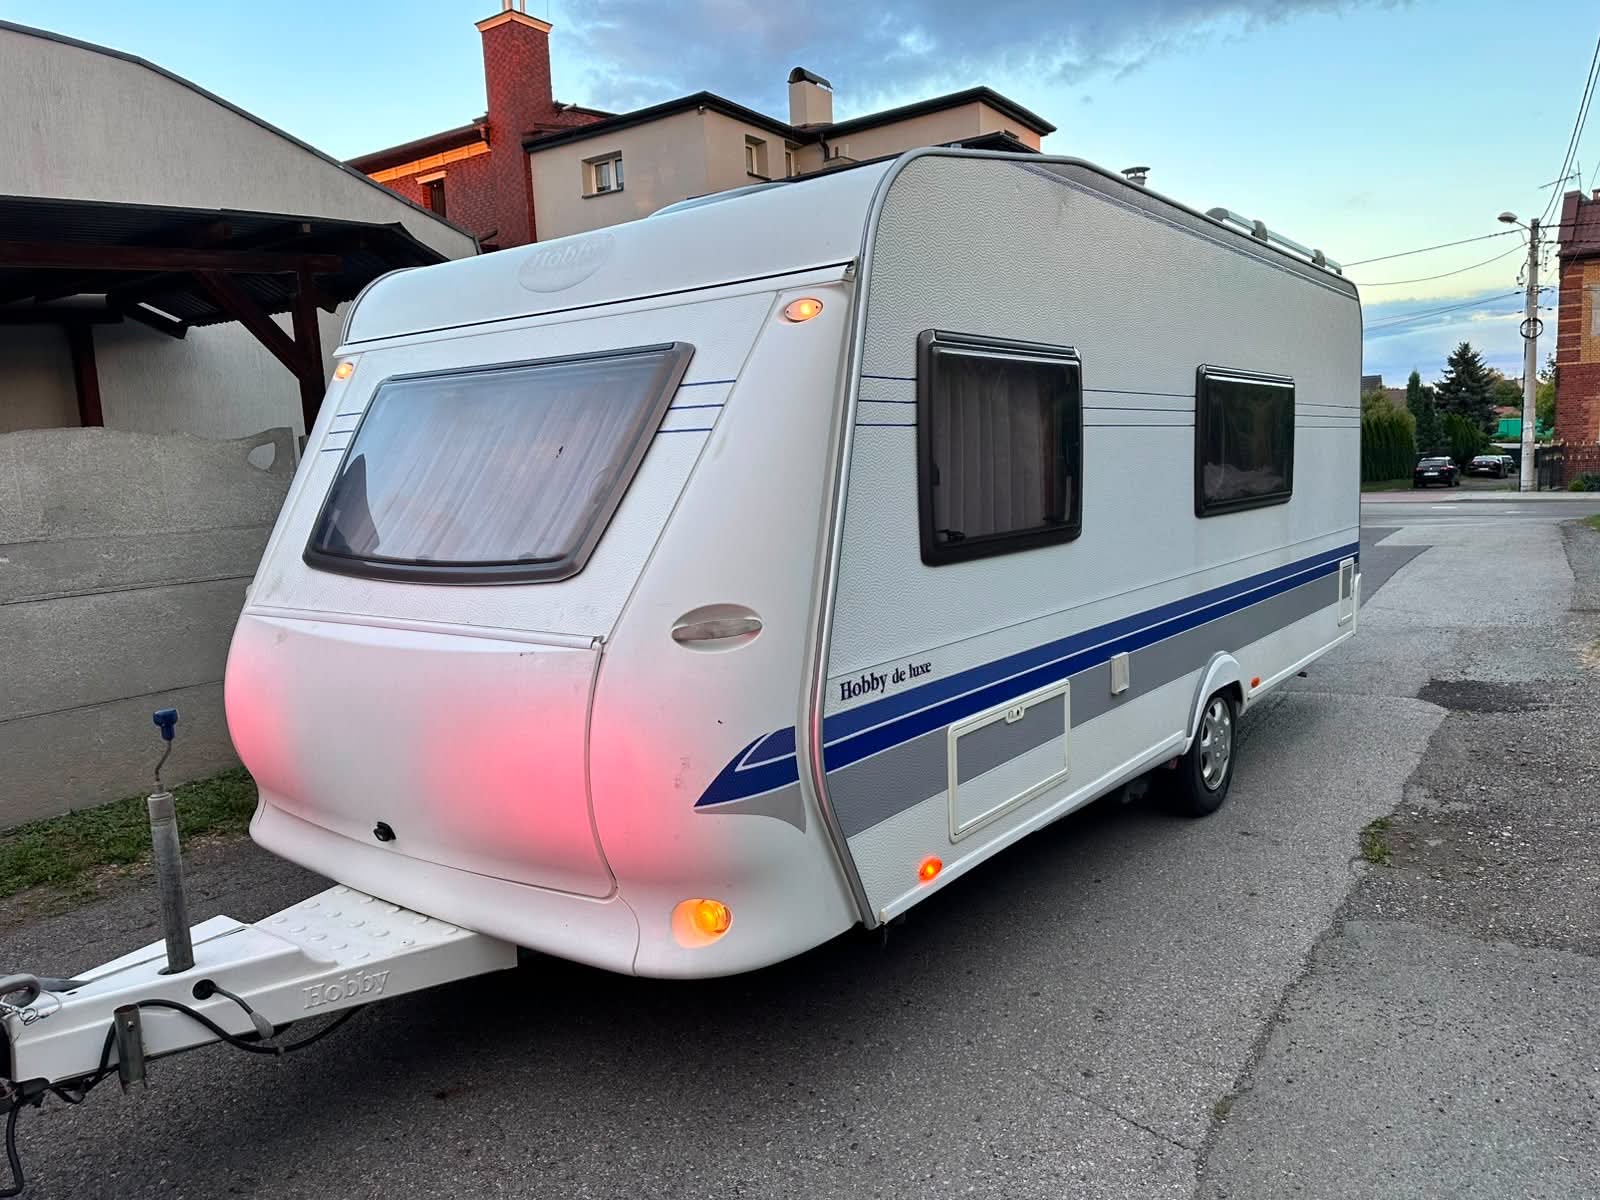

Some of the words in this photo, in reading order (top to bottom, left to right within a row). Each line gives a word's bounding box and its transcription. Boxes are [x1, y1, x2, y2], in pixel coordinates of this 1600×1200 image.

[840, 672, 887, 700] Hobby
[892, 668, 906, 684] de
[909, 662, 932, 678] luxe
[302, 969, 390, 1009] Hobby
